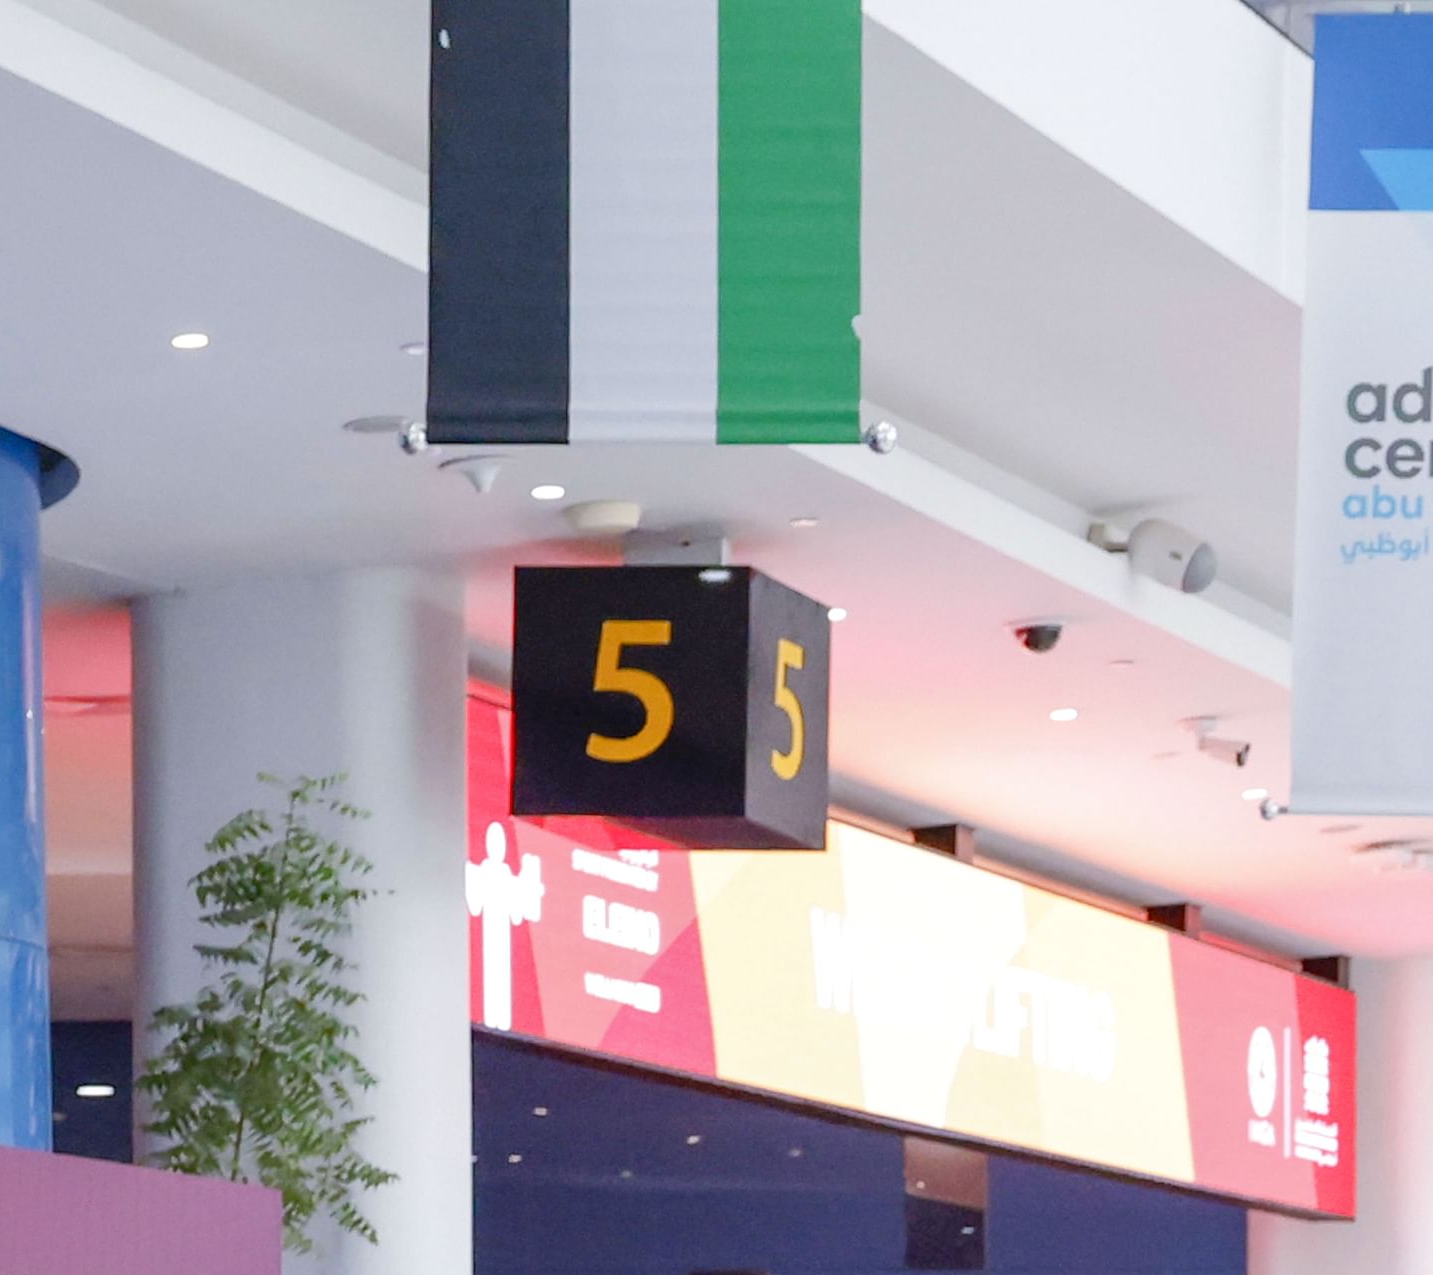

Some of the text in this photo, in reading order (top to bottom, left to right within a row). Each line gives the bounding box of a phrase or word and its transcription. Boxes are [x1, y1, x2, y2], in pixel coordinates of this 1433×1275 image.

[1342, 485, 1423, 520] abu
[586, 620, 675, 763] 5
[771, 638, 806, 780] 5
